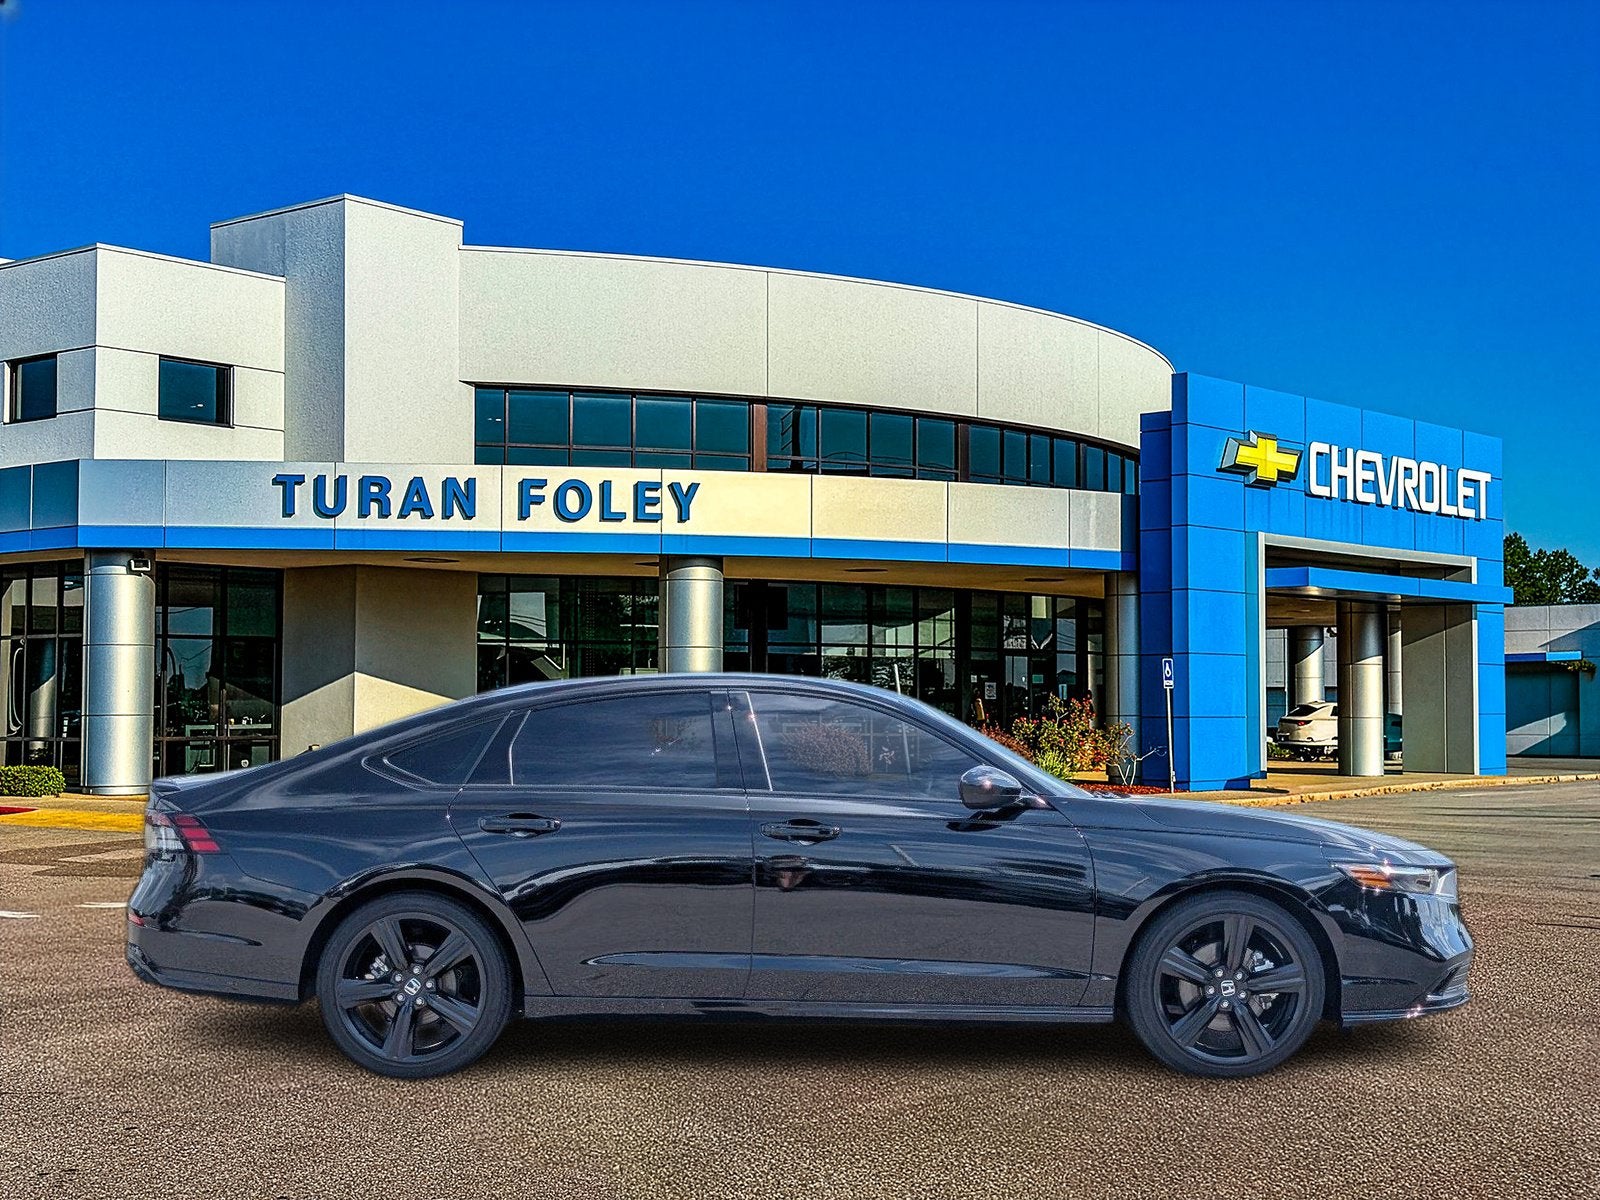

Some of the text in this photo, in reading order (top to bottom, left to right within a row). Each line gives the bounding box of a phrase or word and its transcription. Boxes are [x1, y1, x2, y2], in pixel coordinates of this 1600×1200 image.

[272, 474, 700, 523] TURAN FOLEY
[1308, 441, 1492, 520] CHEVROLET
